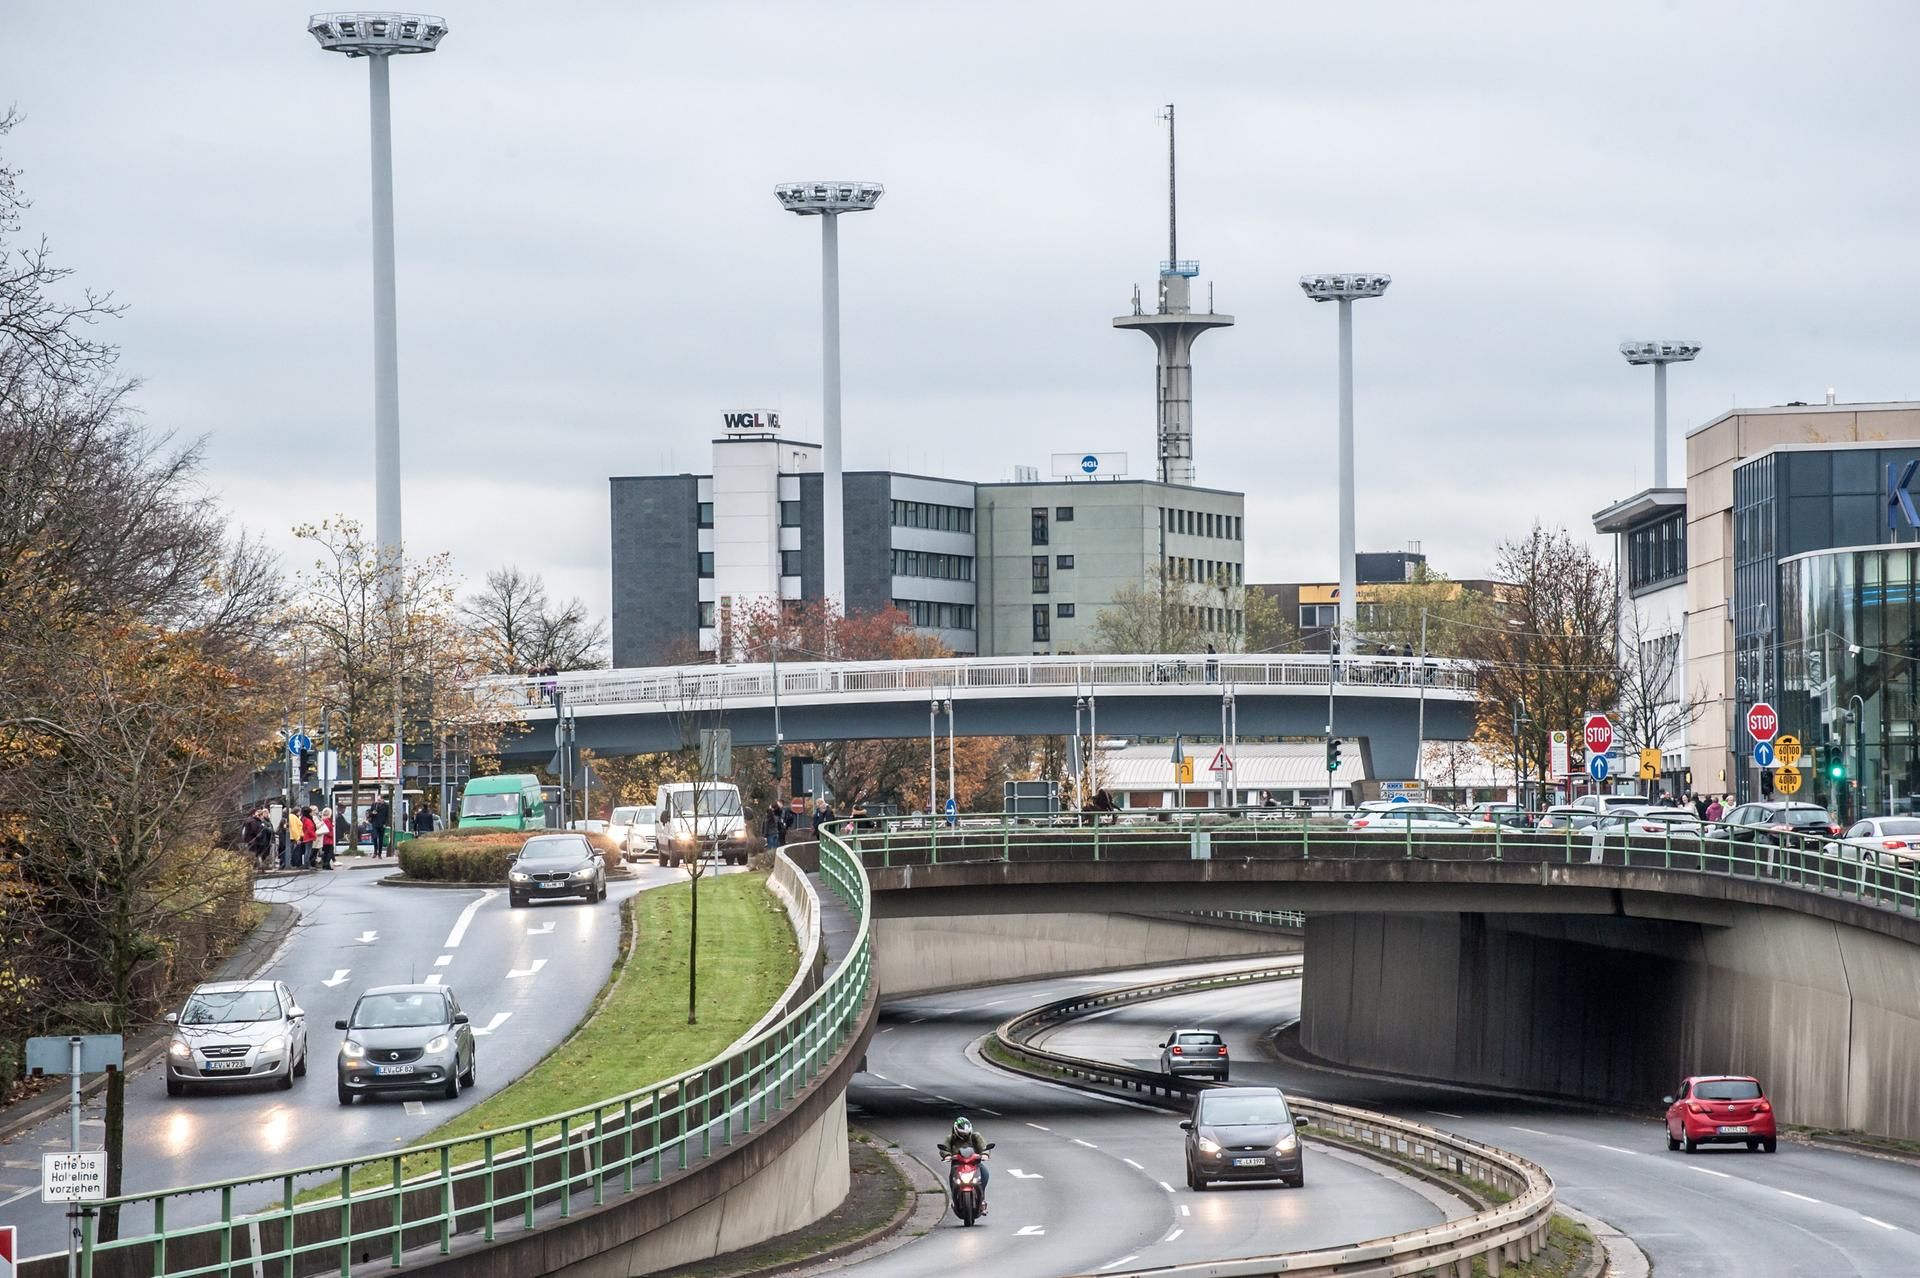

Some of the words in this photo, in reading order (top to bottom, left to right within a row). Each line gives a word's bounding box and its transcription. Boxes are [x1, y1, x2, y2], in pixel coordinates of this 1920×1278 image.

[724, 413, 764, 428] WGL
[1752, 715, 1775, 730] STOP
[1587, 727, 1611, 742] STOP
[1779, 746, 1787, 755] 60
[1788, 746, 1799, 755] 100
[54, 1160, 77, 1170] Bitte
[81, 1160, 95, 1169] bis
[49, 1184, 100, 1194] vorziehen
